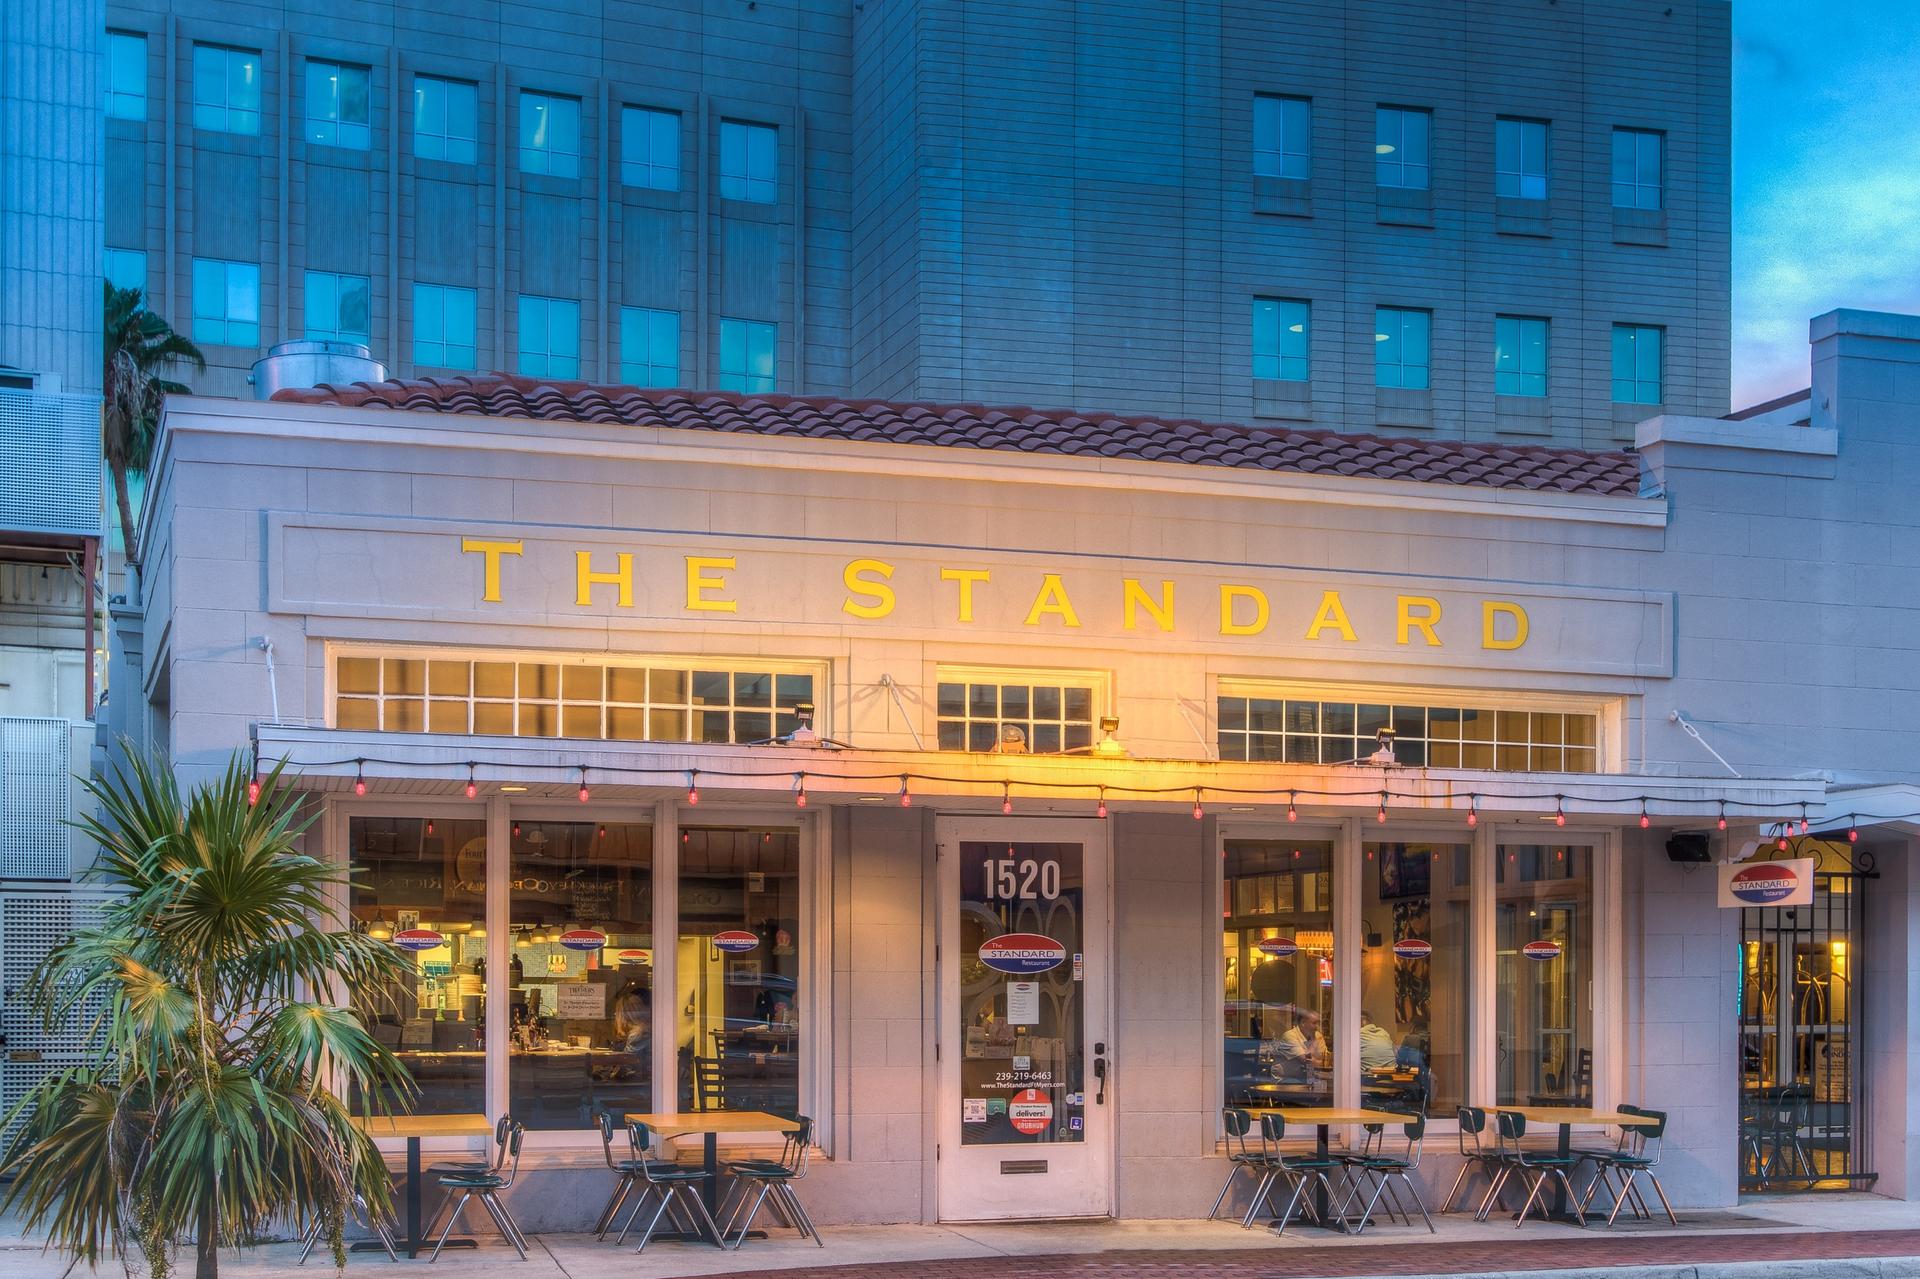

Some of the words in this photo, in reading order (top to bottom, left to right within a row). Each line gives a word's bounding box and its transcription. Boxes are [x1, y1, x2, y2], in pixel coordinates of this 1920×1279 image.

[461, 537, 737, 613] THE
[842, 559, 1530, 651] STANDARD
[983, 859, 1060, 900] 1520
[1738, 880, 1790, 890] STANDARD
[1762, 888, 1786, 897] Restaurant
[991, 950, 1055, 958] STANDARD
[1022, 959, 1050, 967] Restaurant
[995, 1071, 1052, 1080] 239-219-6463
[1015, 1109, 1046, 1117] delivers!
